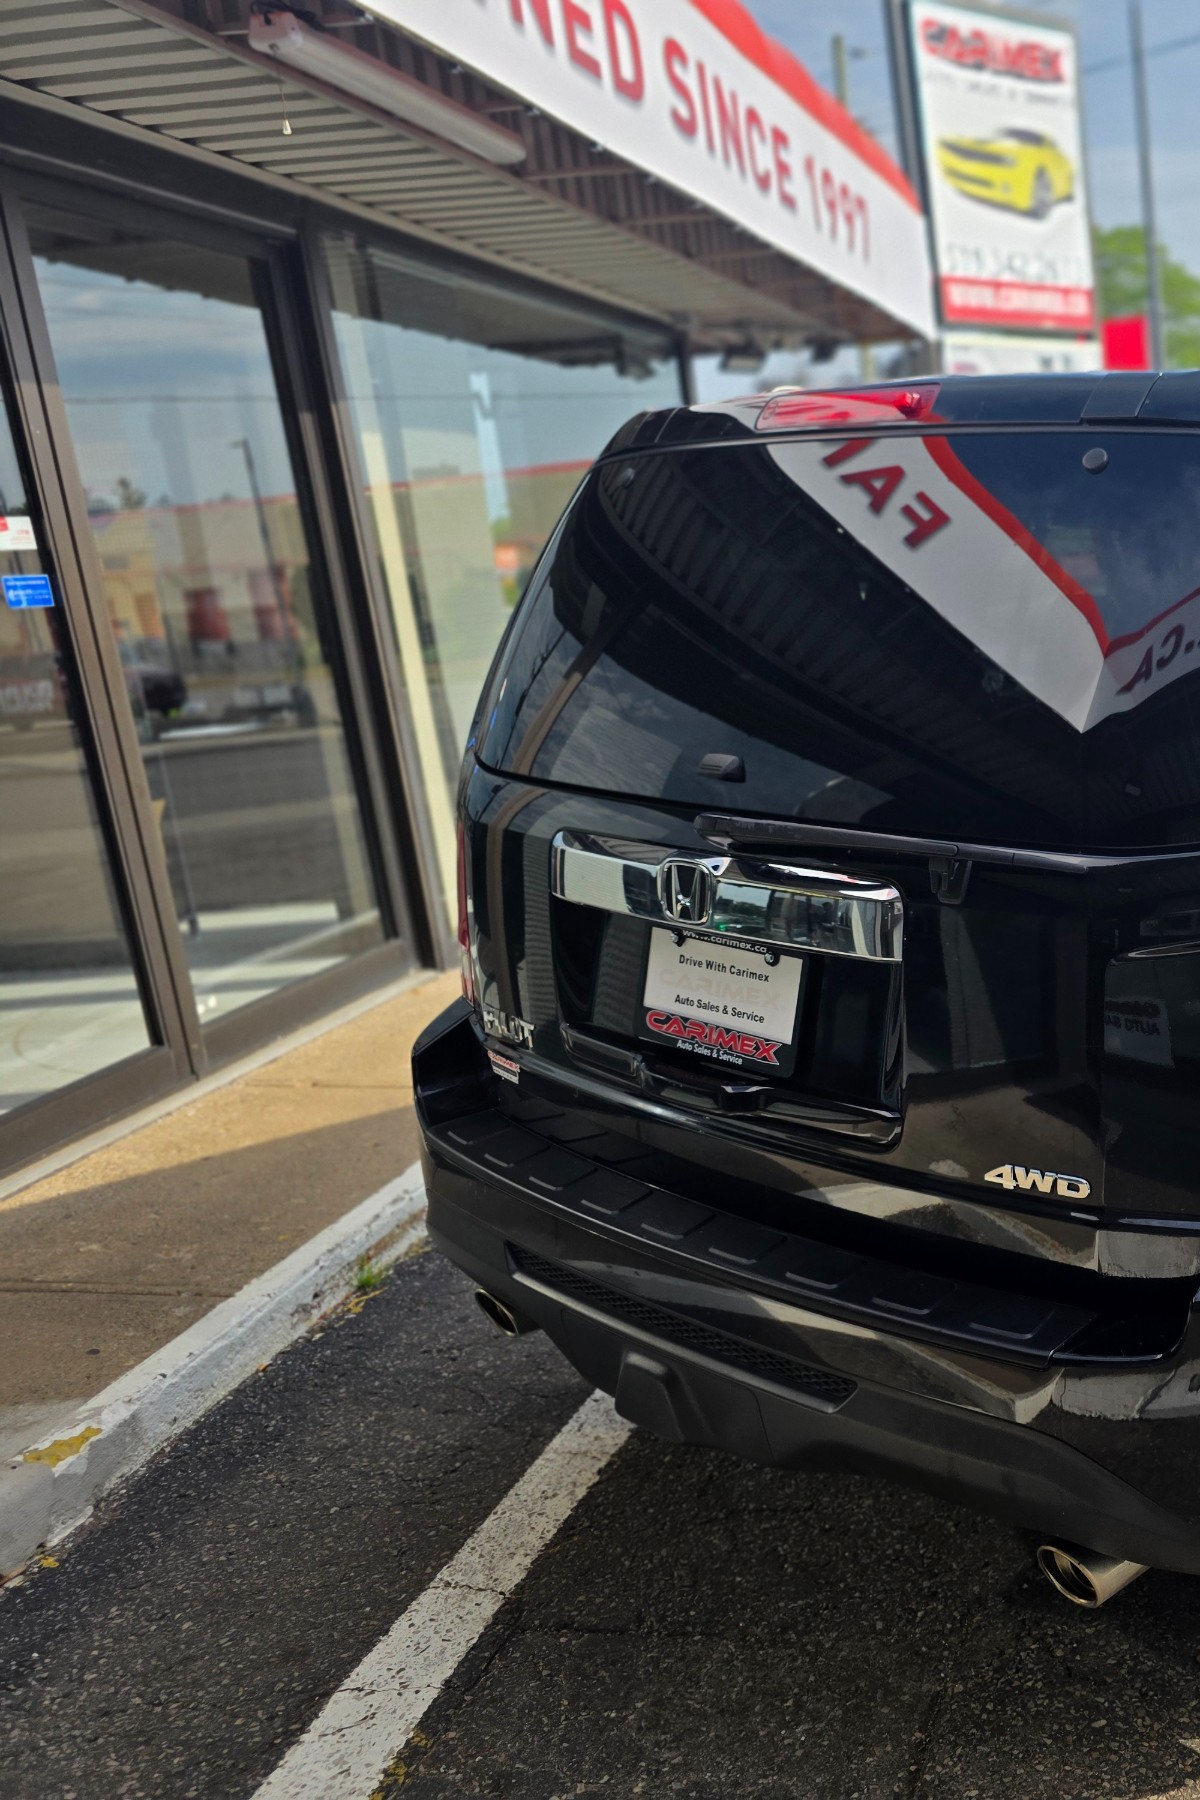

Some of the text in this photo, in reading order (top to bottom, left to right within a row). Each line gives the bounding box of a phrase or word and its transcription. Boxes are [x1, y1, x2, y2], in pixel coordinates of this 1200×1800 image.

[663, 36, 798, 214] SINCE
[804, 155, 871, 260] 1997
[682, 929, 768, 953] w.carimex.ca
[678, 954, 770, 983] Drive With Carimex
[674, 994, 765, 1024] Auto Sales & Service
[646, 1010, 782, 1065] CARIMEX
[676, 1040, 692, 1051] Auto
[693, 1044, 711, 1056] Sales
[719, 1051, 743, 1065] Service
[984, 1164, 1091, 1199] 4WD
